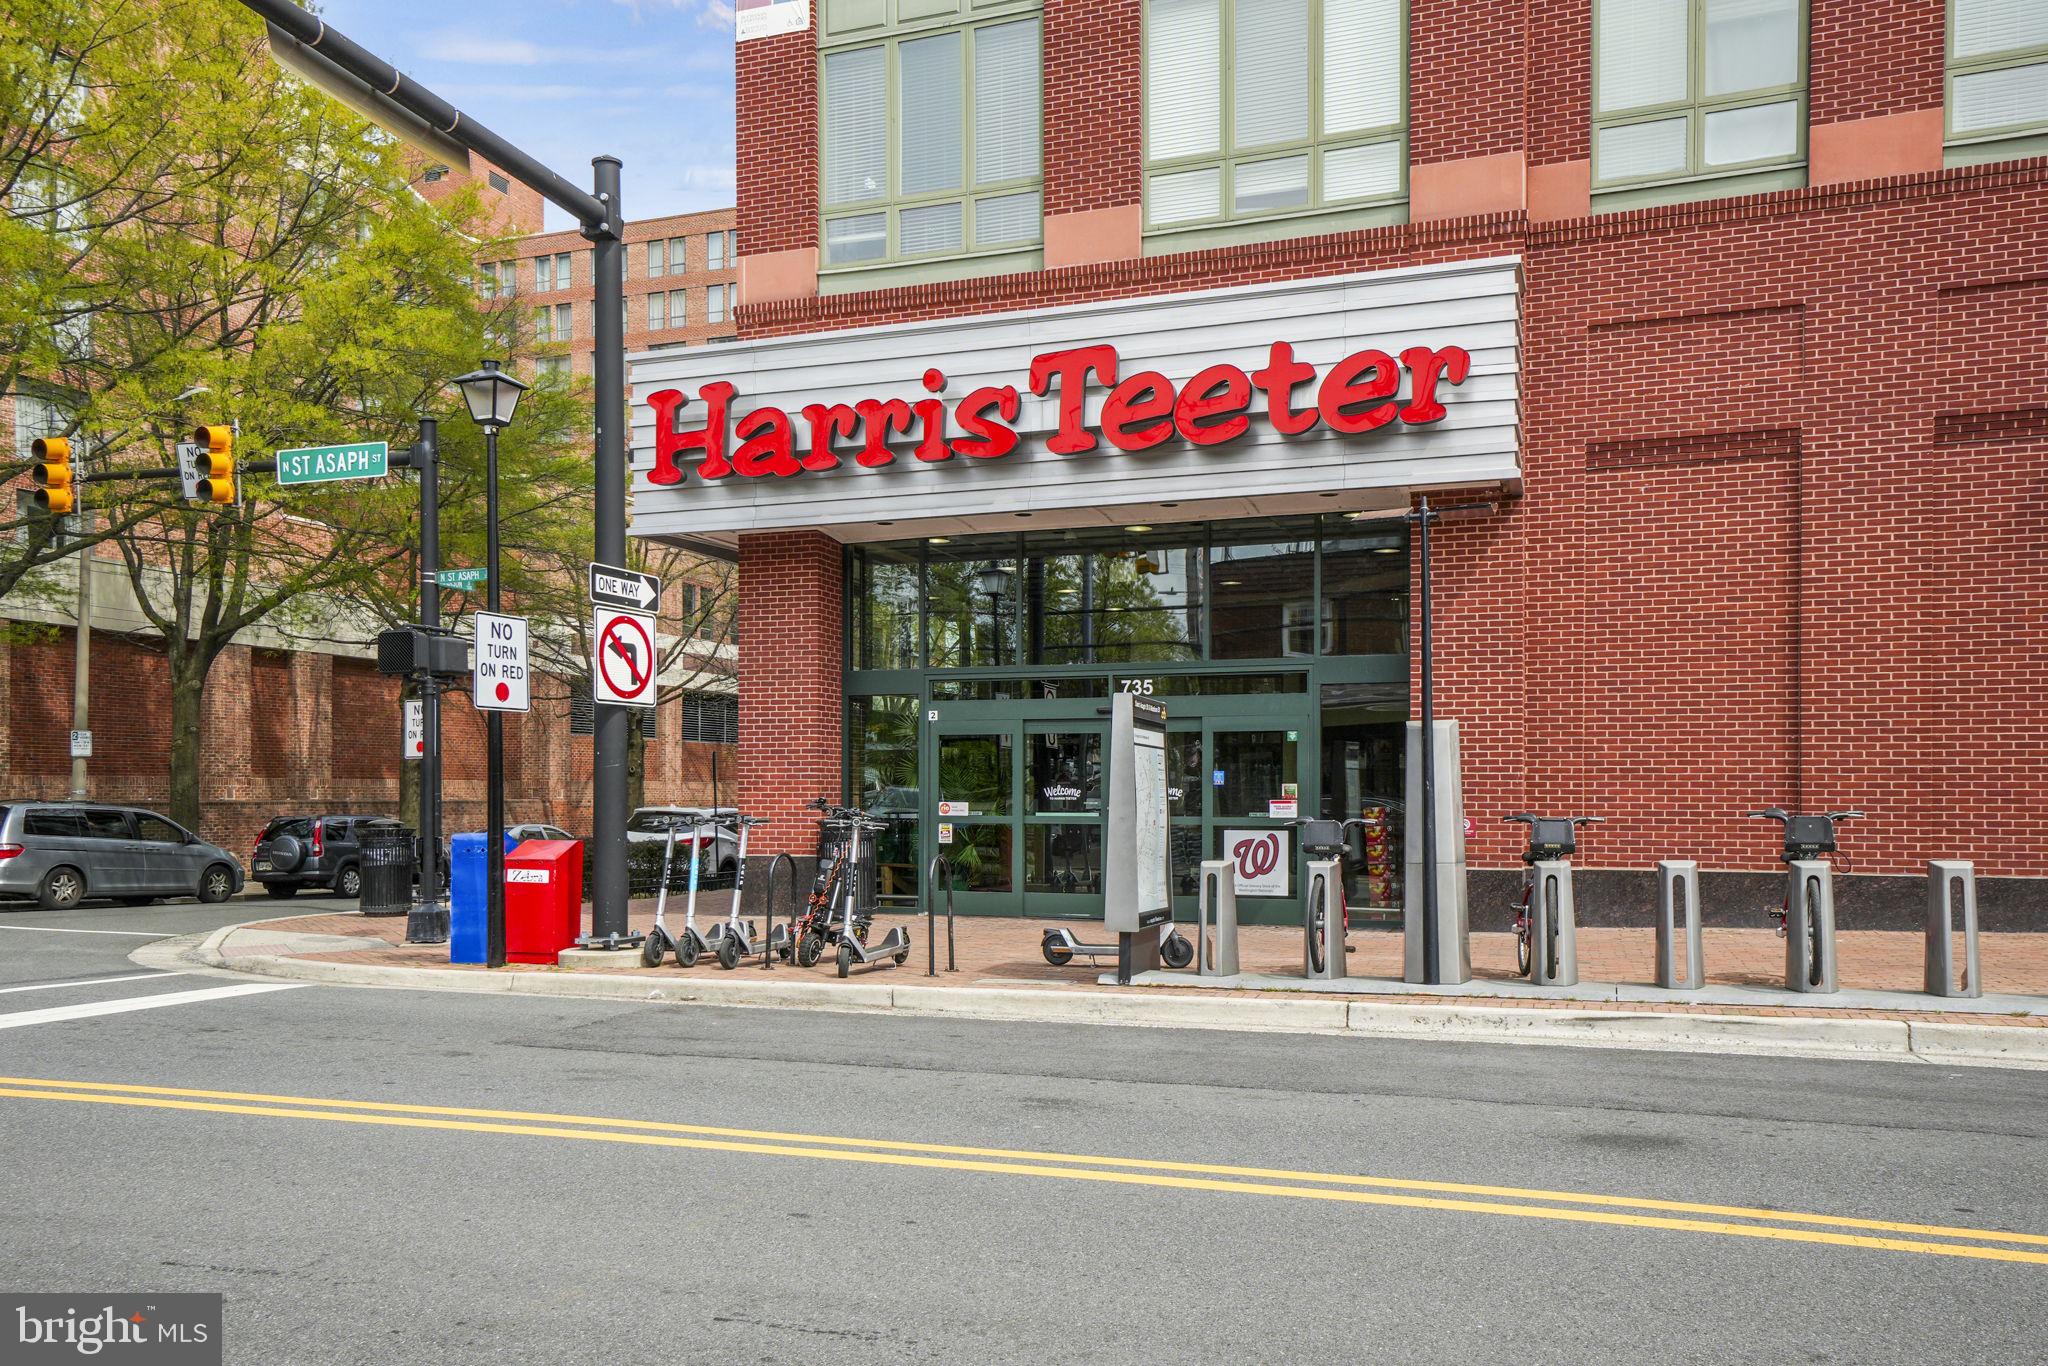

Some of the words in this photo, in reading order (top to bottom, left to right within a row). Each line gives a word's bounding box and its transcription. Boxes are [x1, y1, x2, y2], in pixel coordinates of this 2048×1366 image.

[647, 369, 1019, 485] Harris
[1030, 341, 1471, 454] Teeter
[283, 462, 290, 472] N
[292, 456, 311, 476] ST
[316, 451, 369, 474] ASAPH
[372, 454, 382, 463] ST
[185, 471, 195, 480] ON
[458, 571, 480, 581] ASAPH
[599, 577, 618, 594] ONE
[621, 581, 640, 598] WAY
[491, 621, 513, 641] NO
[487, 644, 517, 660] TURN
[480, 663, 496, 677] ON
[502, 665, 524, 680] RED
[1121, 680, 1154, 696] 735
[930, 711, 936, 719] 2
[408, 730, 418, 739] ON
[1043, 784, 1081, 797] Welcome
[1233, 833, 1279, 879] W
